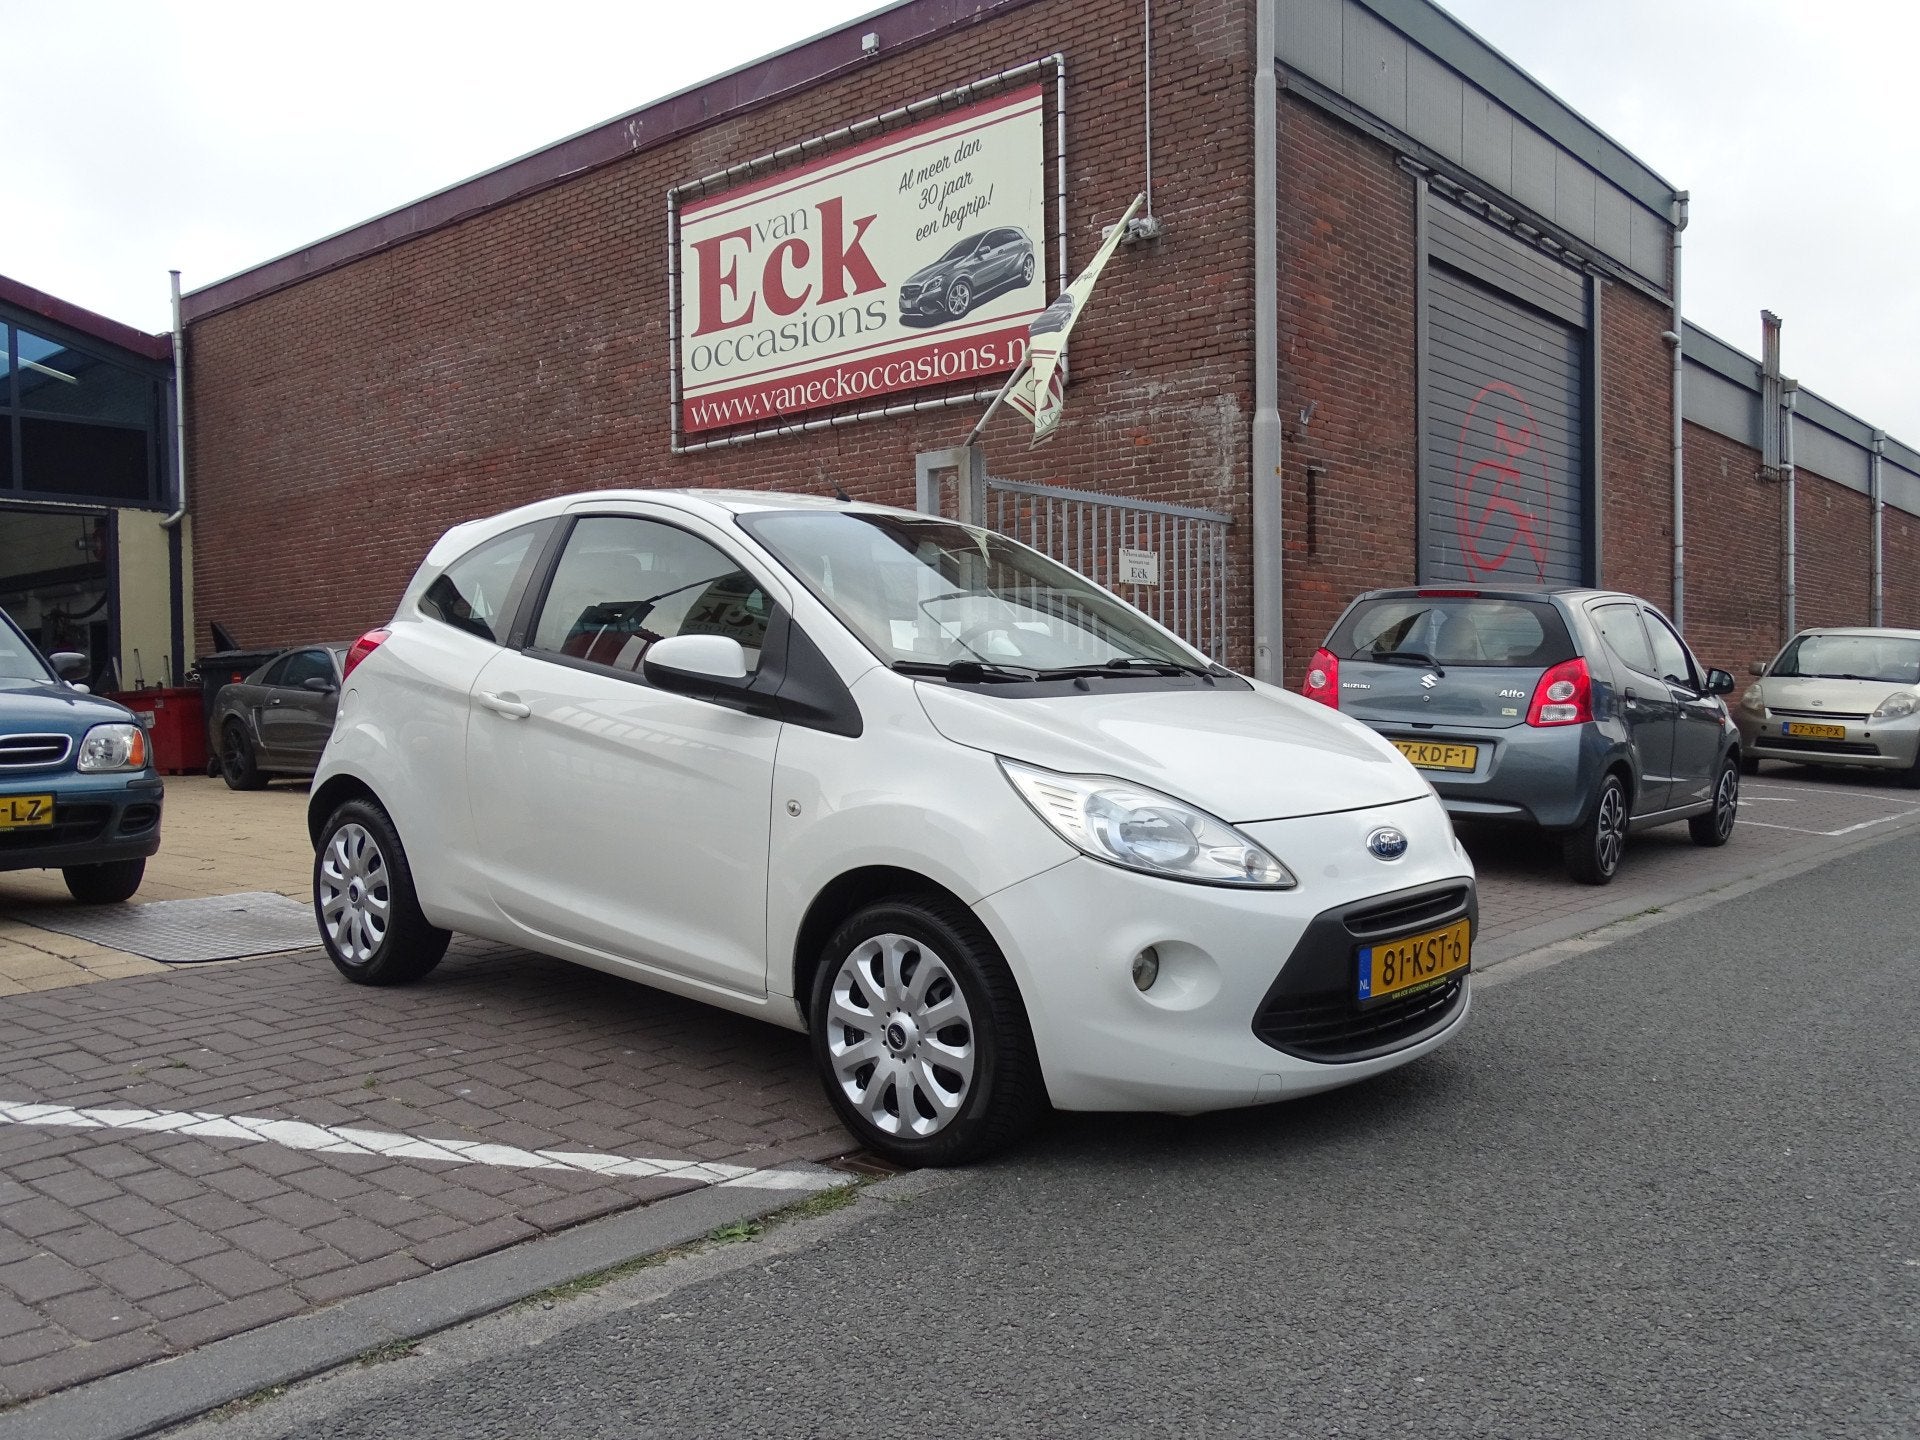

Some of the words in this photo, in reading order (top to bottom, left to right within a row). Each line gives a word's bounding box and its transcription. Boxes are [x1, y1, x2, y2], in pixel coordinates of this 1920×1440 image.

[899, 168, 915, 195] Al
[917, 155, 951, 185] meer
[954, 138, 982, 164] dan
[919, 183, 938, 209] 30
[938, 171, 974, 211] jaar
[754, 208, 809, 243] van
[916, 220, 940, 242] een
[942, 182, 994, 231] begrip!
[690, 195, 887, 338] Eck
[690, 300, 888, 372] occasions
[690, 337, 1026, 427] www.vaneckoccasions.n
[1130, 567, 1148, 579] Eck
[1342, 682, 1371, 690] SUZUKI
[1498, 689, 1526, 699] Alto
[1792, 724, 1841, 736] 27-XP-PX
[1382, 928, 1462, 986] 81-KST-6
[1360, 979, 1370, 991] NL
